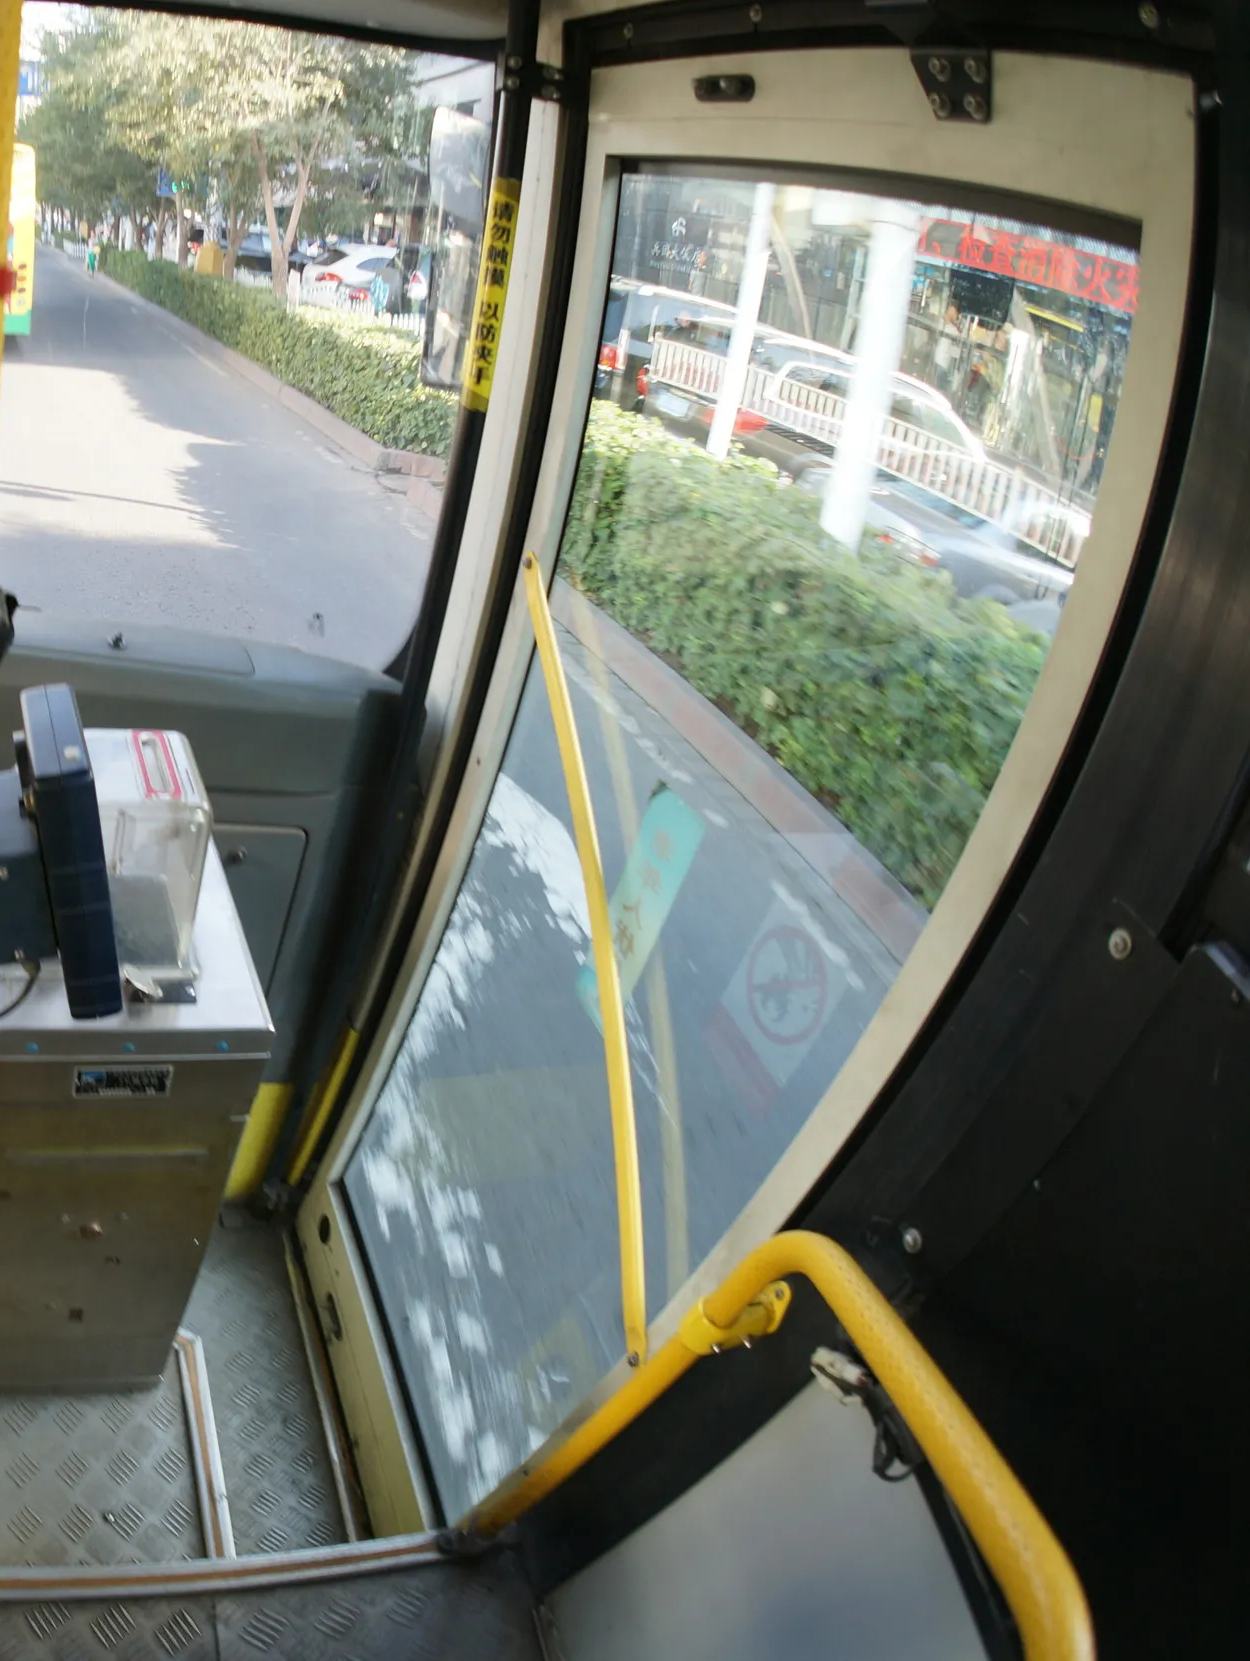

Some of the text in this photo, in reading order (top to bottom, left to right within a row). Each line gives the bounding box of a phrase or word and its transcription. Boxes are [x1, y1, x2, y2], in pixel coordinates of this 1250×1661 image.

[471, 200, 515, 386] 请勿触摸 以防夹手
